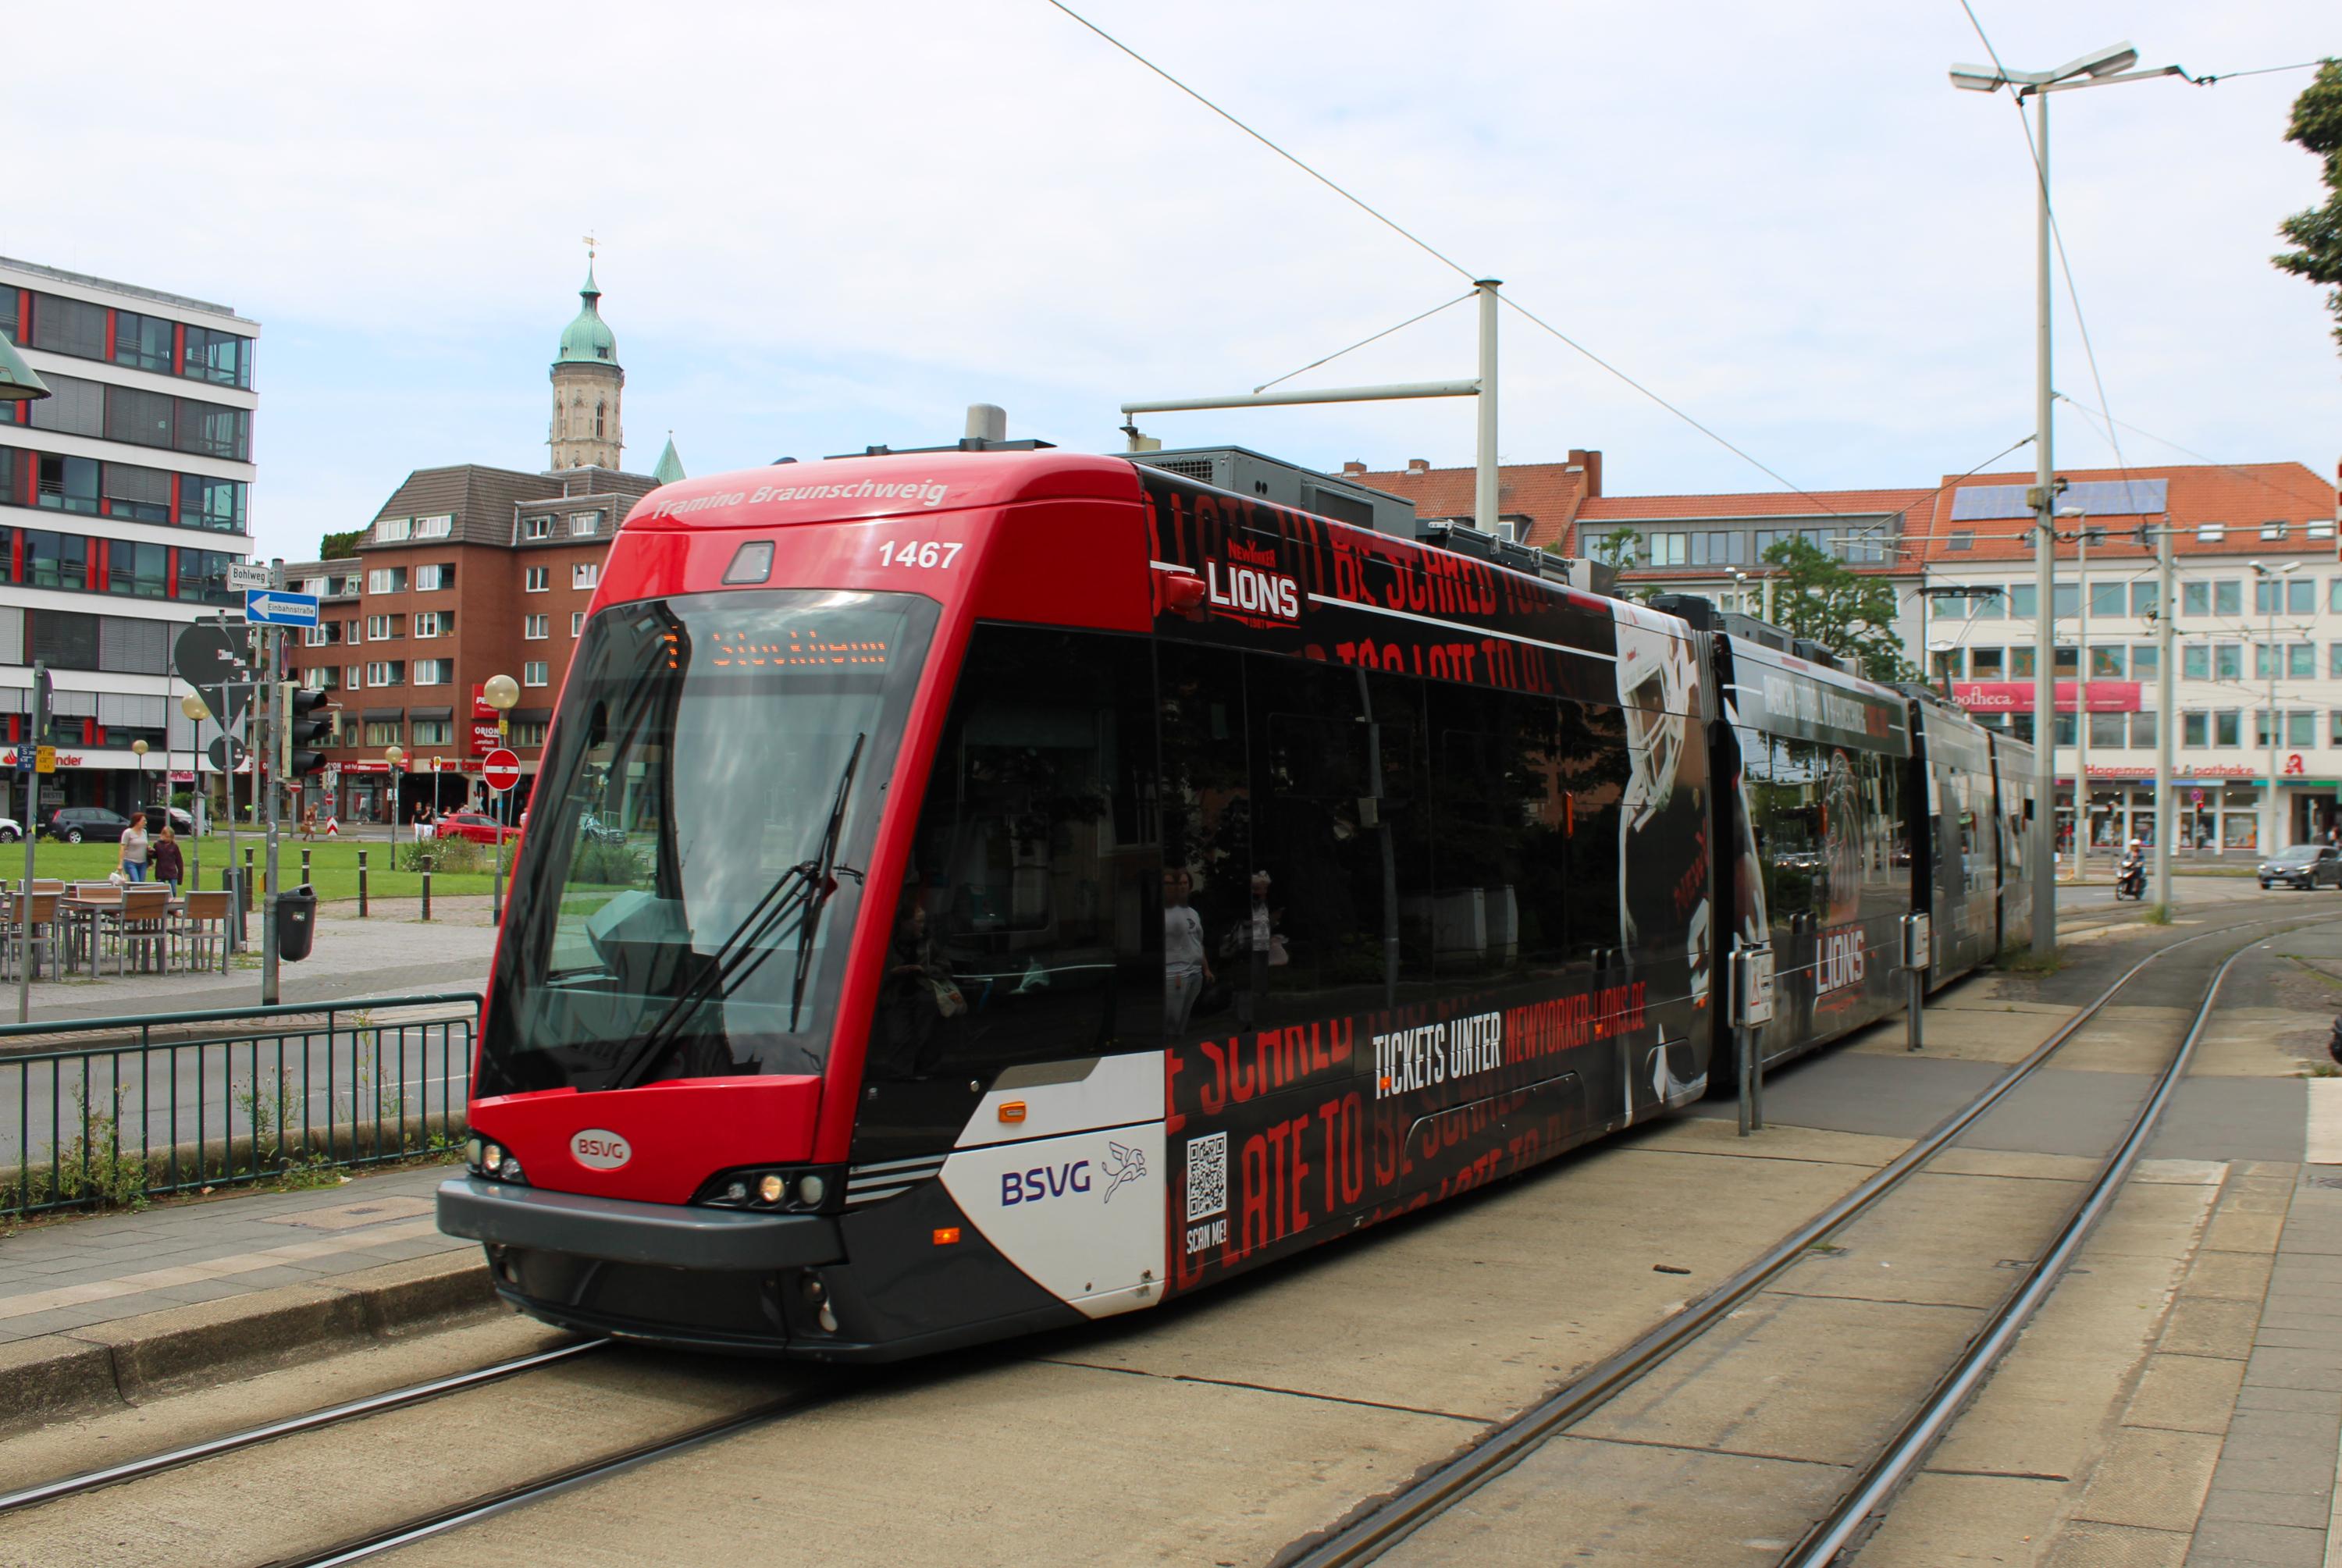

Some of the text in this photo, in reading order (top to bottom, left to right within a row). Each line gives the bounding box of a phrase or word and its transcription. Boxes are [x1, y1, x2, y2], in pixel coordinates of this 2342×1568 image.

[650, 478, 949, 521] Tramino Braunschweig
[877, 540, 963, 569] 1467
[233, 567, 266, 583] Bohlweg
[1208, 560, 1299, 619] LIONS
[267, 603, 315, 615] Einbahnstraße
[2084, 763, 2177, 779] Hagenmat
[1816, 930, 1865, 995] LIONS
[1372, 1022, 1445, 1100] TICKETS
[1450, 1012, 1500, 1079] UNTER
[578, 1138, 624, 1160] BSVG
[1002, 1160, 1091, 1207] BSVG
[1186, 1218, 1227, 1255] SCAN ME!
